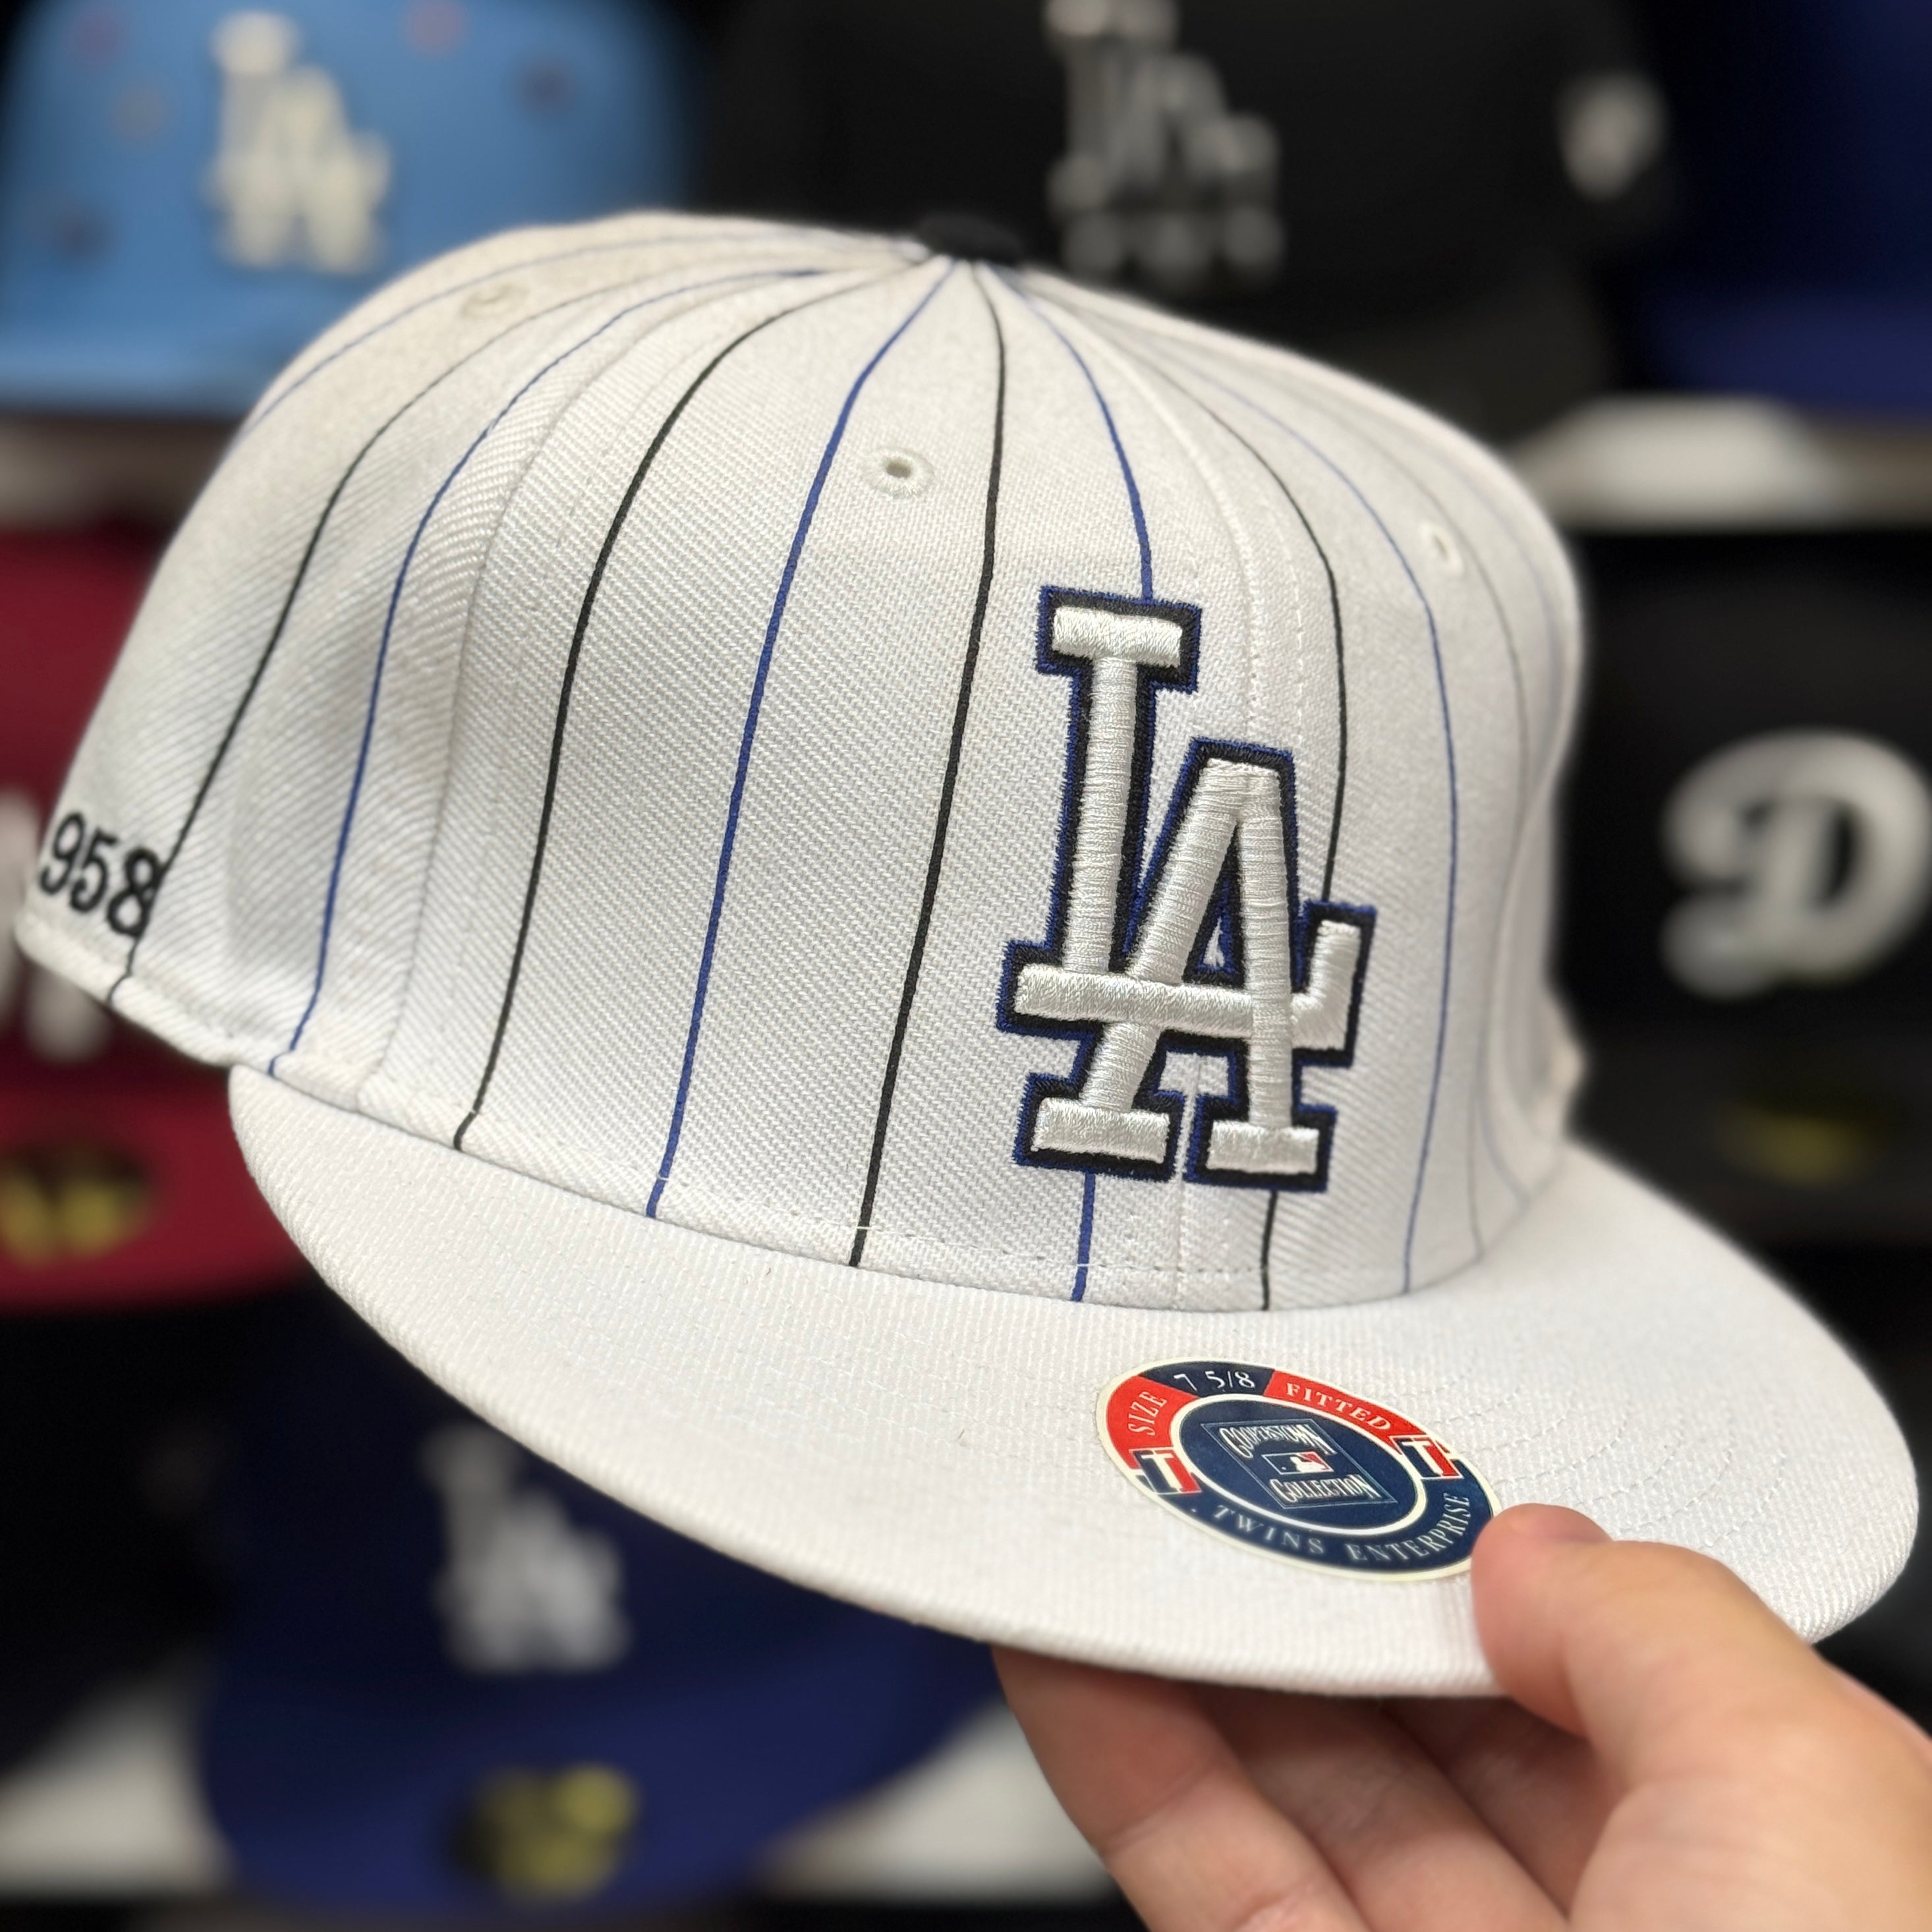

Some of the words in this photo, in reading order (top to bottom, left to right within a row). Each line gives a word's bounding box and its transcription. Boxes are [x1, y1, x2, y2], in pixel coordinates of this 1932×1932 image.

[39, 810, 165, 940] 958
[996, 584, 1377, 1191] LA
[1127, 1390, 1168, 1436] SIZE
[1173, 1373, 1198, 1392] 7
[1205, 1370, 1255, 1389] 5/8
[1286, 1382, 1391, 1431] FITTED
[1219, 1423, 1337, 1459] COOPERSTOWN
[1214, 1504, 1324, 1554] TWINS
[1344, 1492, 1471, 1561] ENTERPRISE
